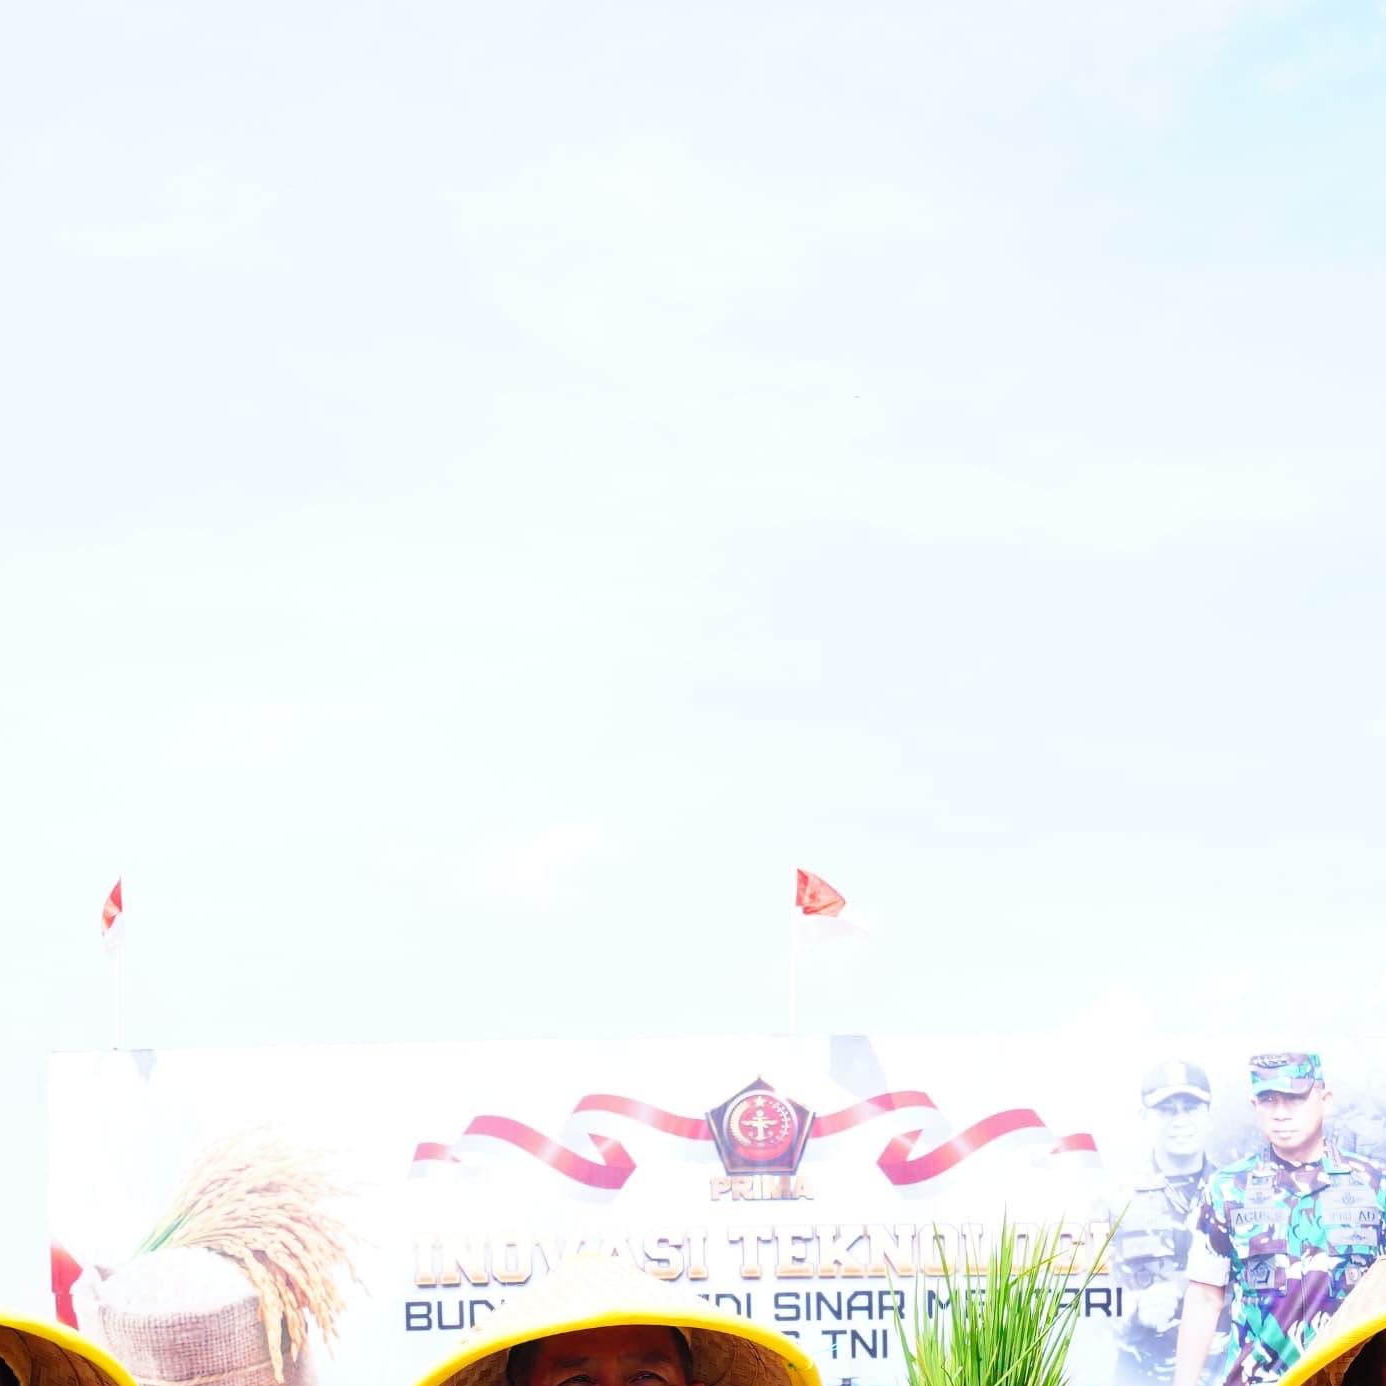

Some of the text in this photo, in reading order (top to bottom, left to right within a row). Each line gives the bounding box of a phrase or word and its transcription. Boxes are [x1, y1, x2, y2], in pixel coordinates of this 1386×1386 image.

[710, 1175, 815, 1202] PRIMA
[773, 1289, 906, 1322] SINAR
[821, 1329, 889, 1360] TNI
